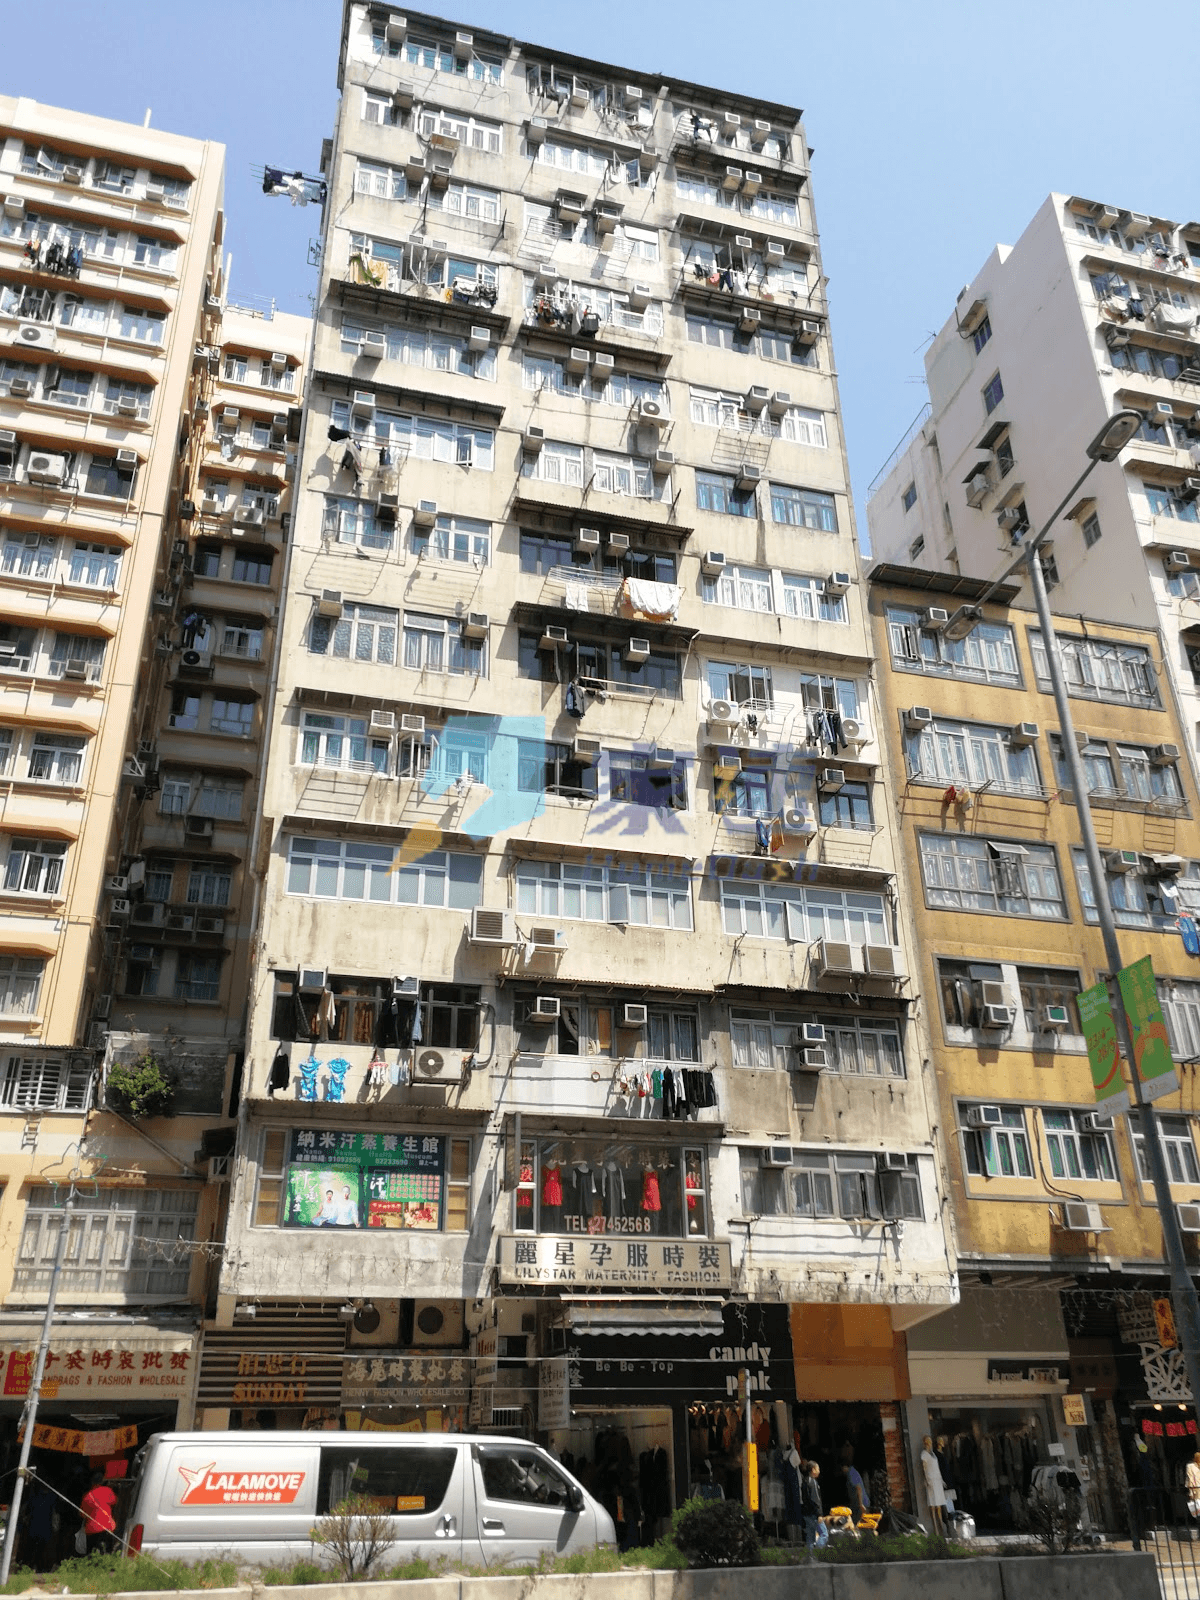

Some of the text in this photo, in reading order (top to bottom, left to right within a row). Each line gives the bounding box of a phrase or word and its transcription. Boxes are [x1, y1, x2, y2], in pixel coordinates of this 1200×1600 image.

[297, 1131, 439, 1153] 納米汗蒸養生館
[515, 1240, 720, 1269] 麗星孕服時裝
[514, 1268, 720, 1283] LILYSTAR MATERNITY FASHION
[709, 1342, 771, 1367] candy
[596, 1361, 610, 1372] Be
[620, 1361, 634, 1372] Be
[650, 1361, 674, 1373] Top
[87, 1375, 93, 1386] &
[98, 1375, 132, 1386] FASHION
[139, 1375, 186, 1386] WHOLESALE
[726, 1370, 771, 1396] pnk
[233, 1382, 308, 1402] SUNDAY
[408, 1387, 451, 1396] WHOLESALE
[205, 1474, 301, 1490] LALAMOVE
